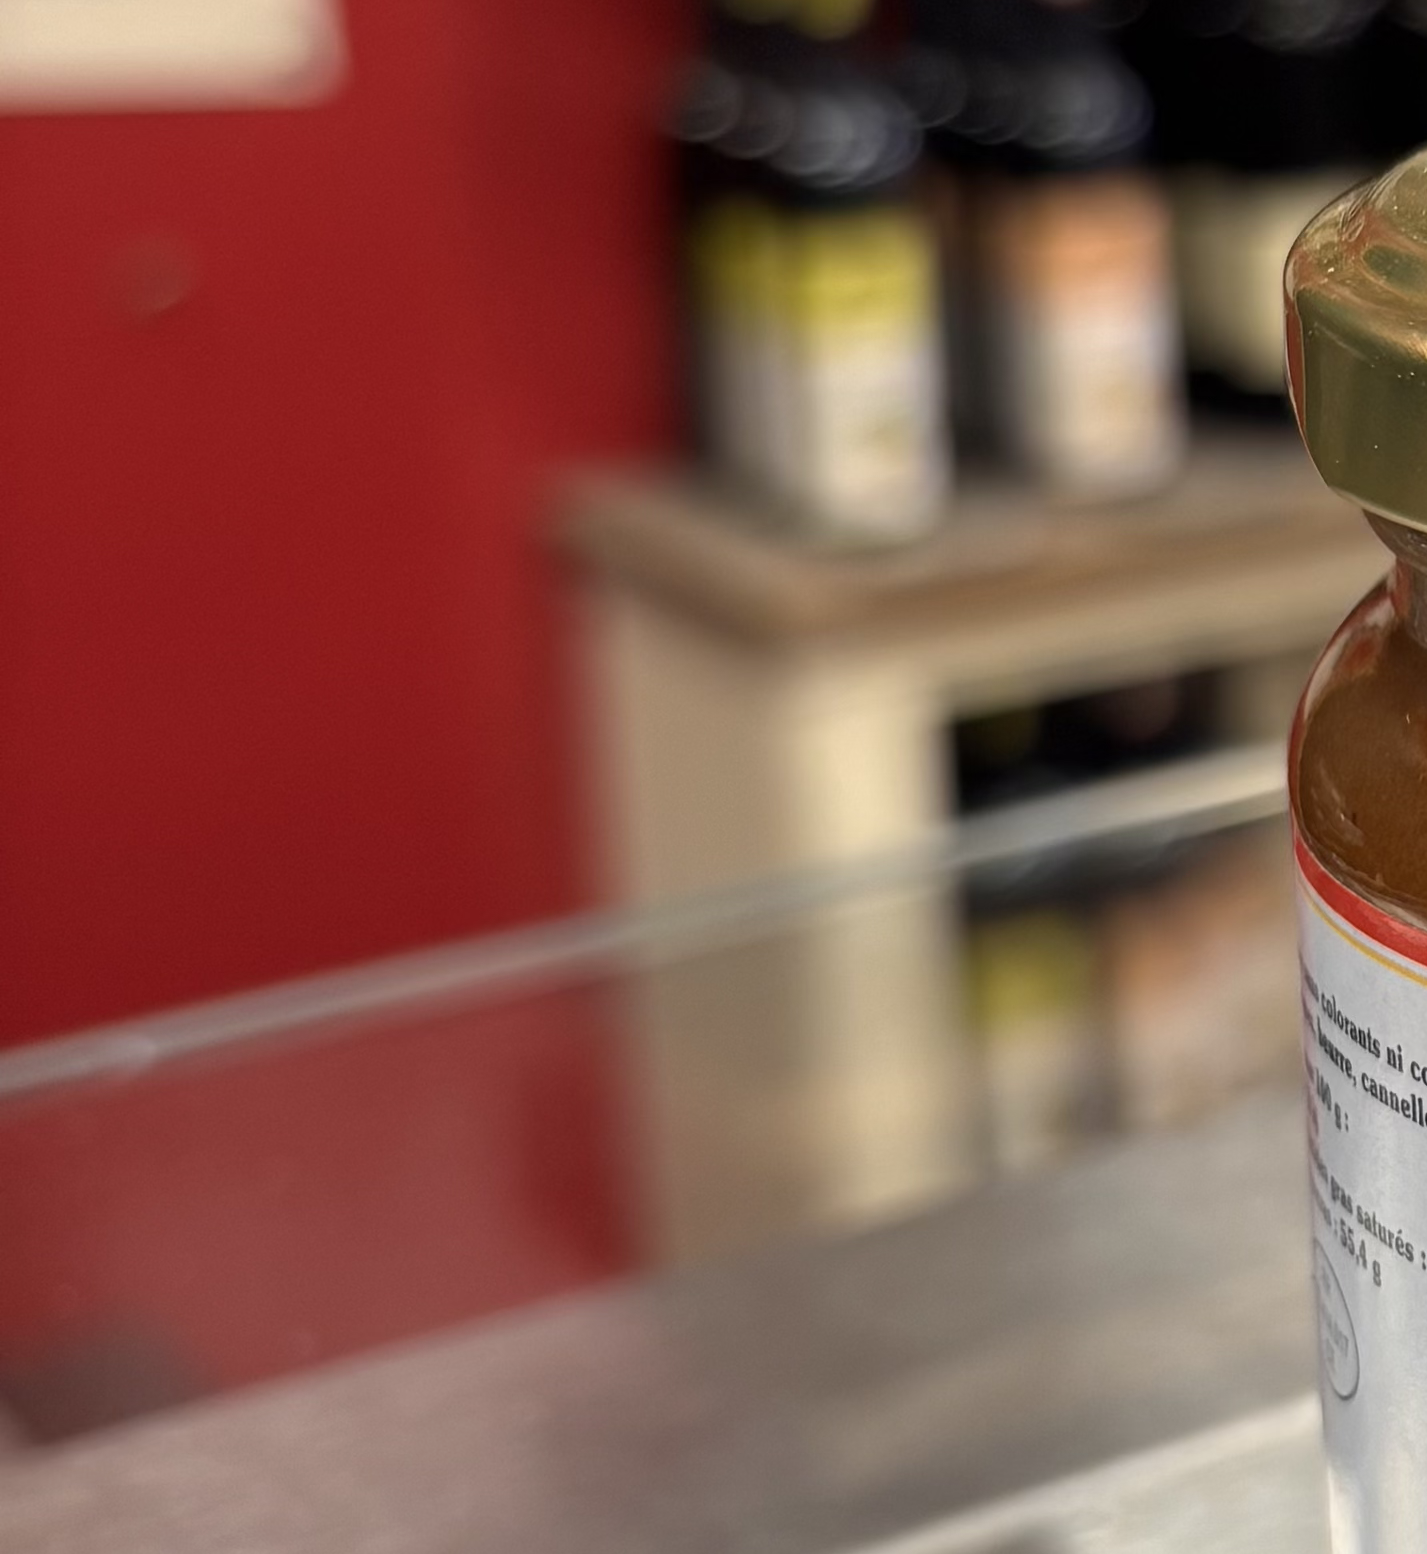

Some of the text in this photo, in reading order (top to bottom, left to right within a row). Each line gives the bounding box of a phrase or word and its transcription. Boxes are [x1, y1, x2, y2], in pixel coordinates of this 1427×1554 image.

[1321, 992, 1381, 1058] colorants
[1386, 1044, 1404, 1073] ni
[1339, 1217, 1367, 1269] 55,4
[1356, 1204, 1414, 1263] saturés
